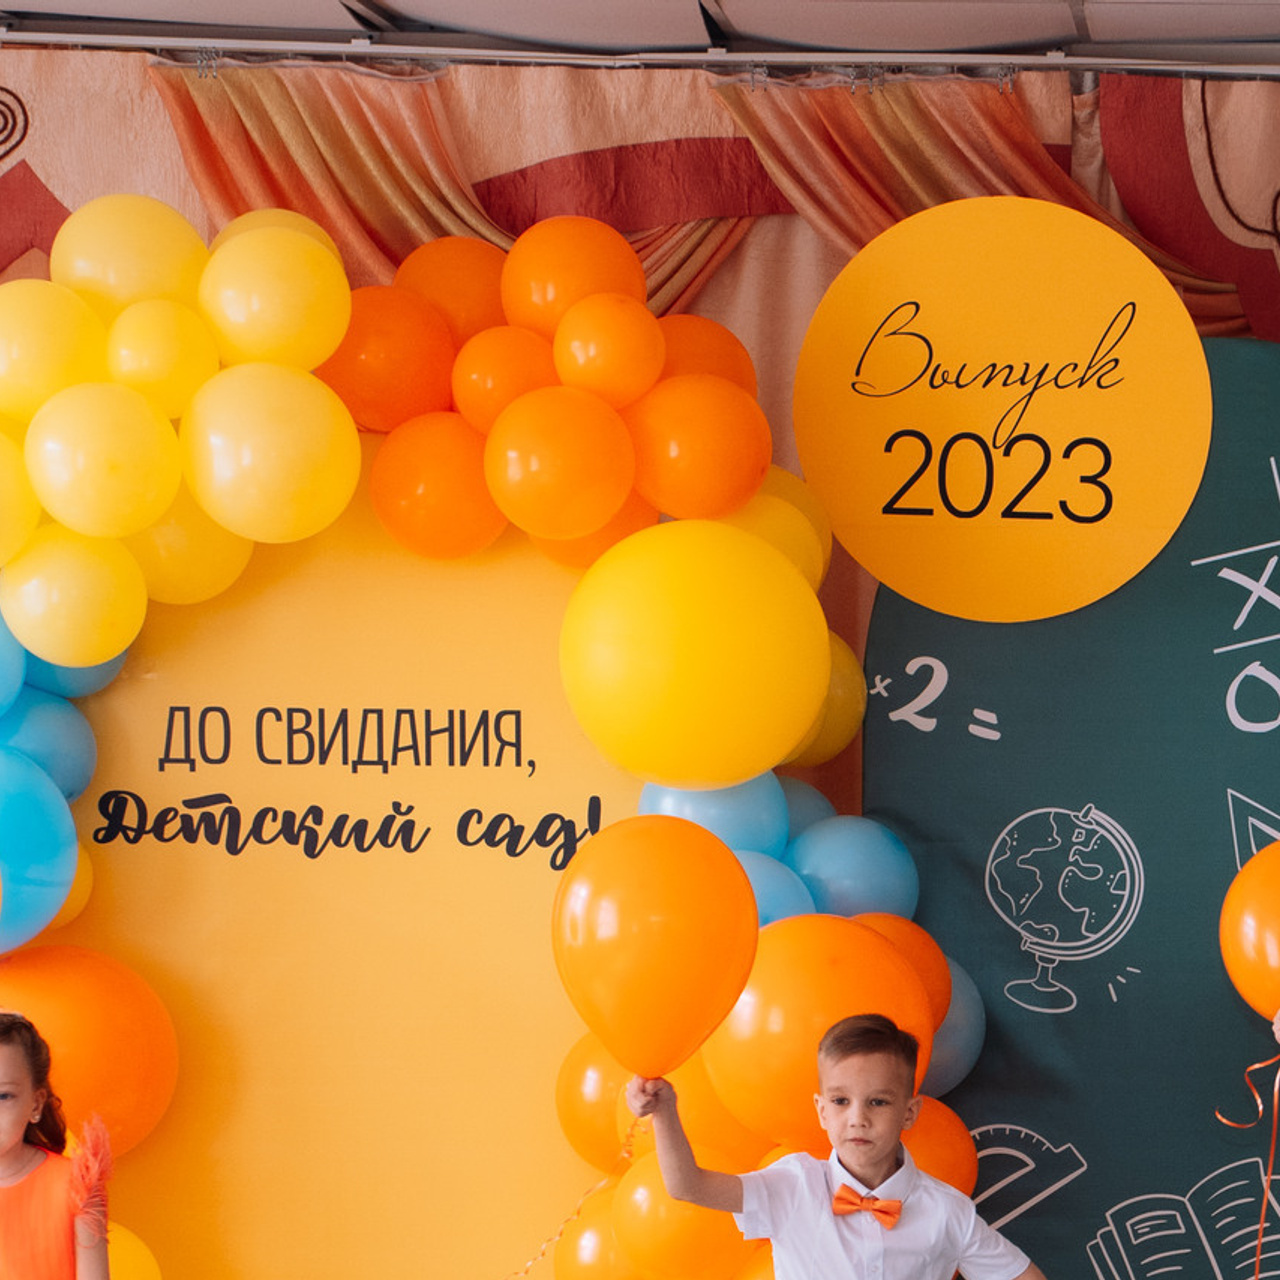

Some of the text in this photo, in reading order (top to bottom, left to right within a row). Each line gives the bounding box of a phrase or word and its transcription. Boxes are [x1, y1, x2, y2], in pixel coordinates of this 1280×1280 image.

[851, 301, 1137, 450] Выпуск
[882, 429, 1113, 524] 2023
[158, 705, 537, 778] ДО СВИДАНИЯ,
[92, 790, 601, 872] Детский сад!
